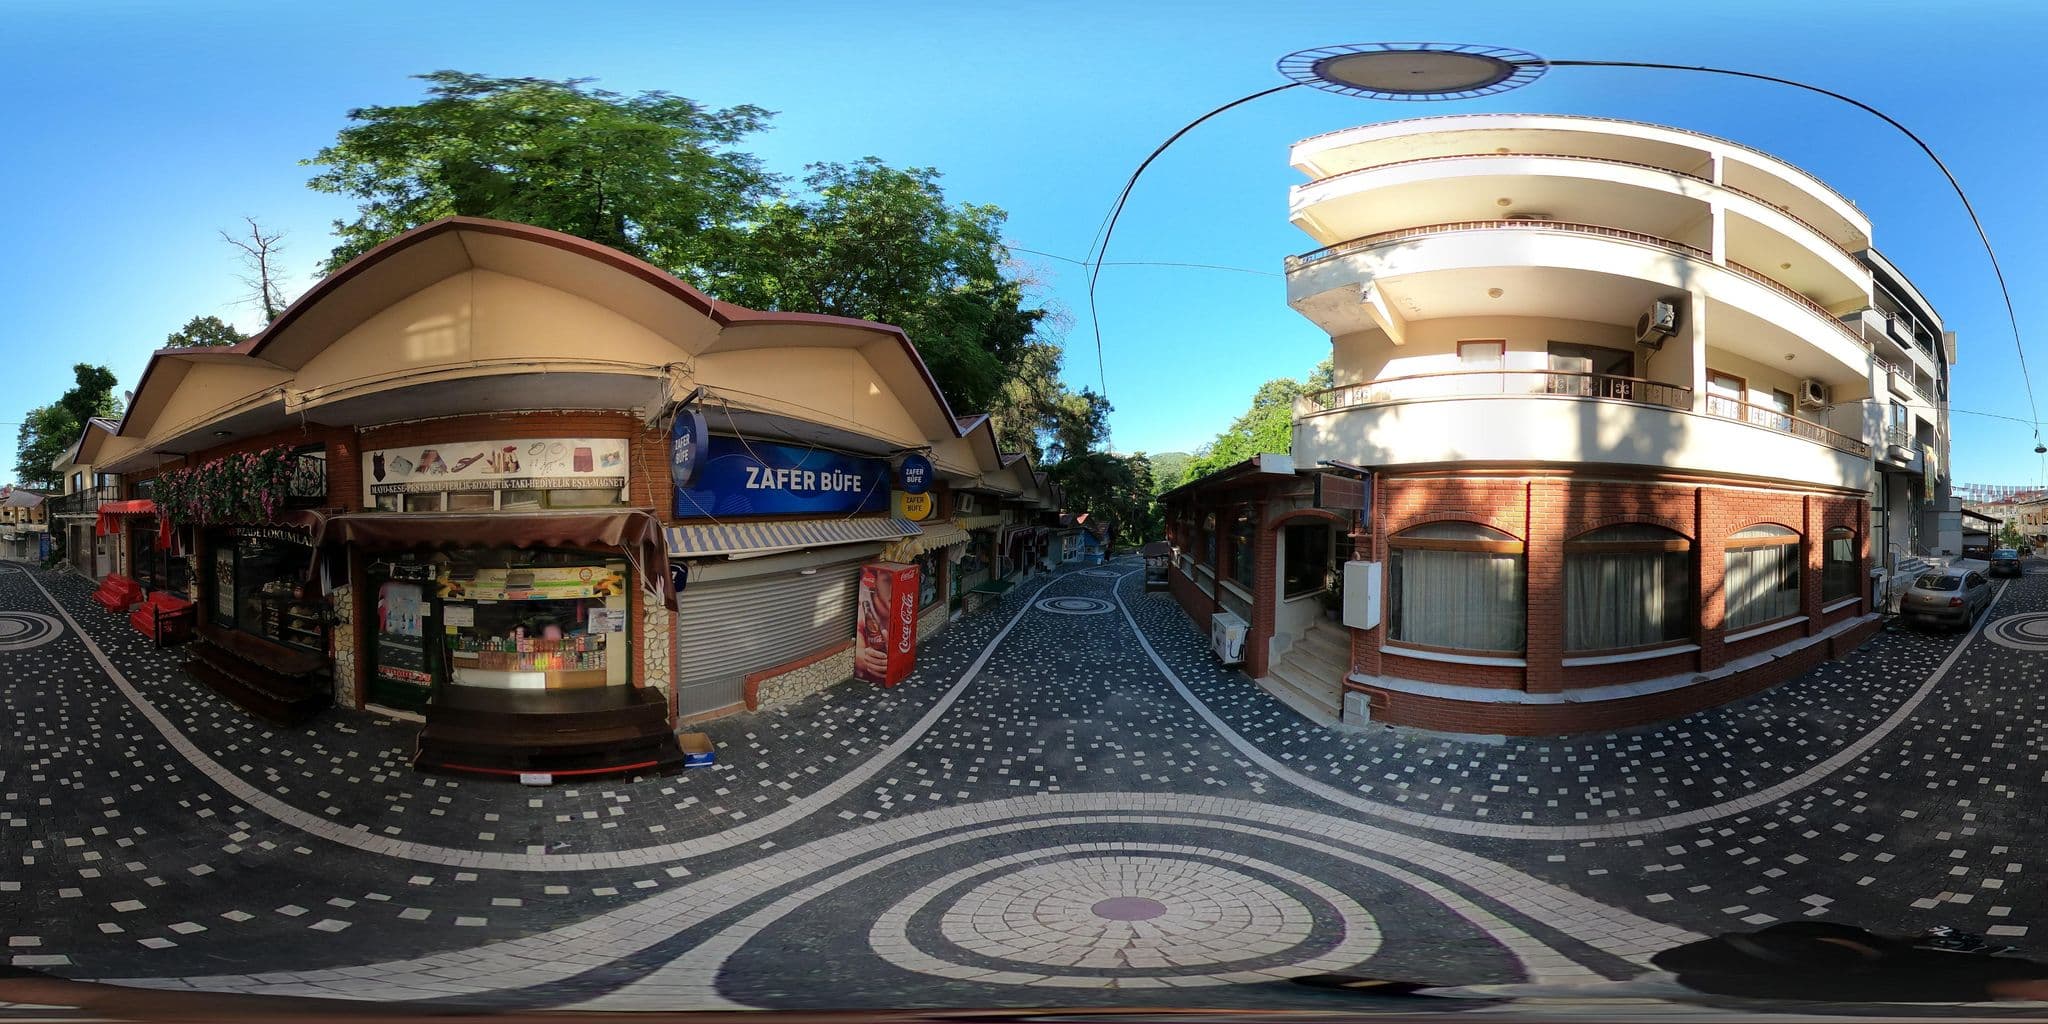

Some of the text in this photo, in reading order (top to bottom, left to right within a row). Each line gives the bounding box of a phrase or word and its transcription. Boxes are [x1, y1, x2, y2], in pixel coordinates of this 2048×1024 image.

[675, 433, 690, 450] ZAFER
[675, 449, 689, 465] BÜFE
[746, 466, 862, 493] ZAFER BÜFE
[906, 474, 922, 483] BÜFE
[906, 496, 924, 504] ZAFER
[906, 503, 924, 512] BÜFE
